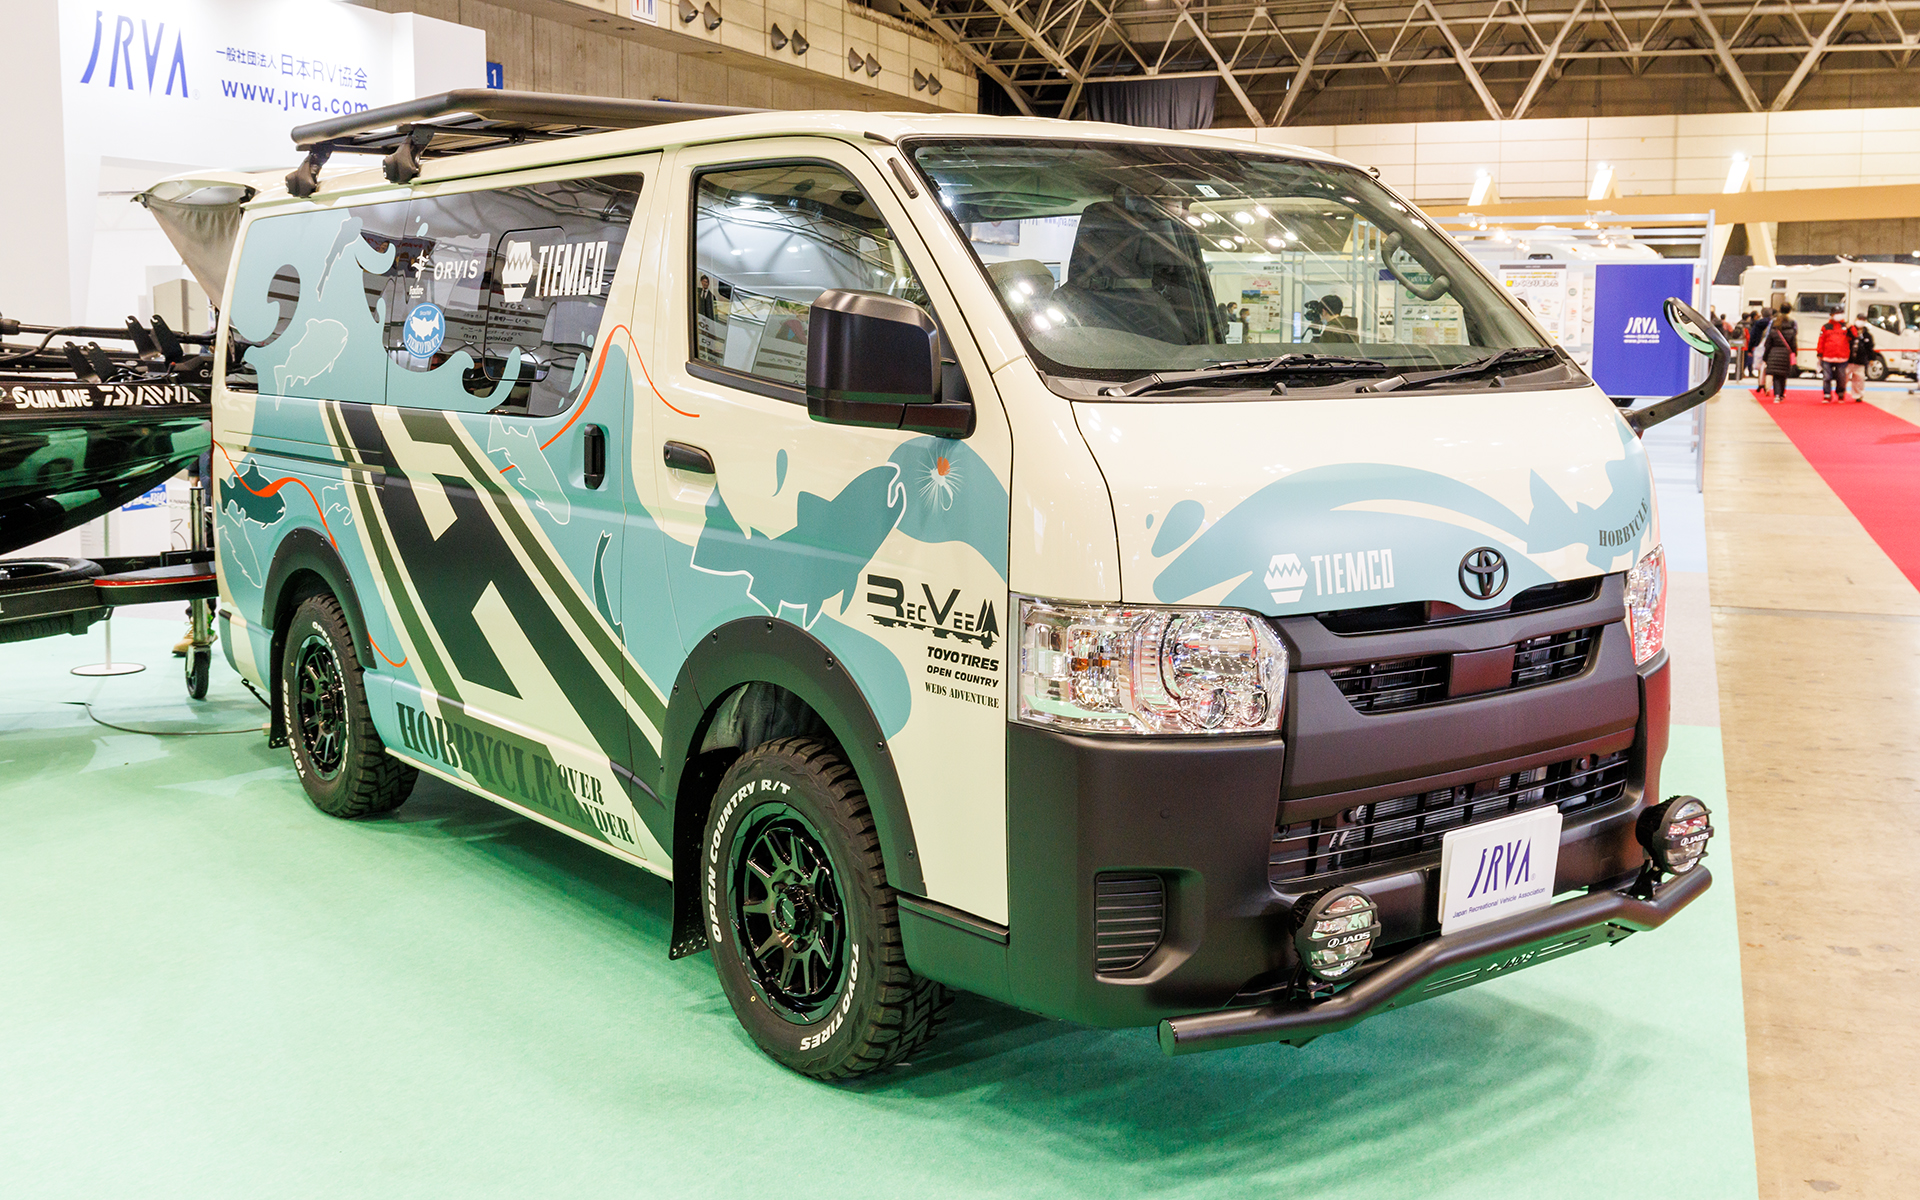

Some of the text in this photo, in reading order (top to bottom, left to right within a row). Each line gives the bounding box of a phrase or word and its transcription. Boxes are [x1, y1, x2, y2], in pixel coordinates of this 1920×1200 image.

[80, 10, 189, 98] JRVA
[216, 47, 367, 90] 一般社団法人 日本RV協会
[221, 79, 369, 115] www.jrva.com
[433, 259, 478, 281] ORVIS
[535, 241, 608, 297] TIEMCO
[1623, 317, 1658, 334] JRVA
[12, 386, 94, 409] SUNLINE
[1599, 497, 1649, 547] HOBBYCLE
[1310, 548, 1395, 596] TIEMCO
[926, 665, 999, 688] OPEN COUNTRY
[927, 646, 999, 672] TOYO TIRES
[925, 681, 1000, 709] WEDS ADVENTURE
[396, 701, 561, 814] HOBBYCLE
[558, 763, 605, 806] OVER
[560, 793, 635, 845] LANDER
[708, 779, 791, 943] OPEN COUNTRY R/T
[1467, 837, 1532, 899] JRVA
[1452, 887, 1546, 919] Japan Recreational Vehicle Association
[1340, 931, 1371, 946] JAOS
[800, 943, 859, 1051] TOYO TIRES
